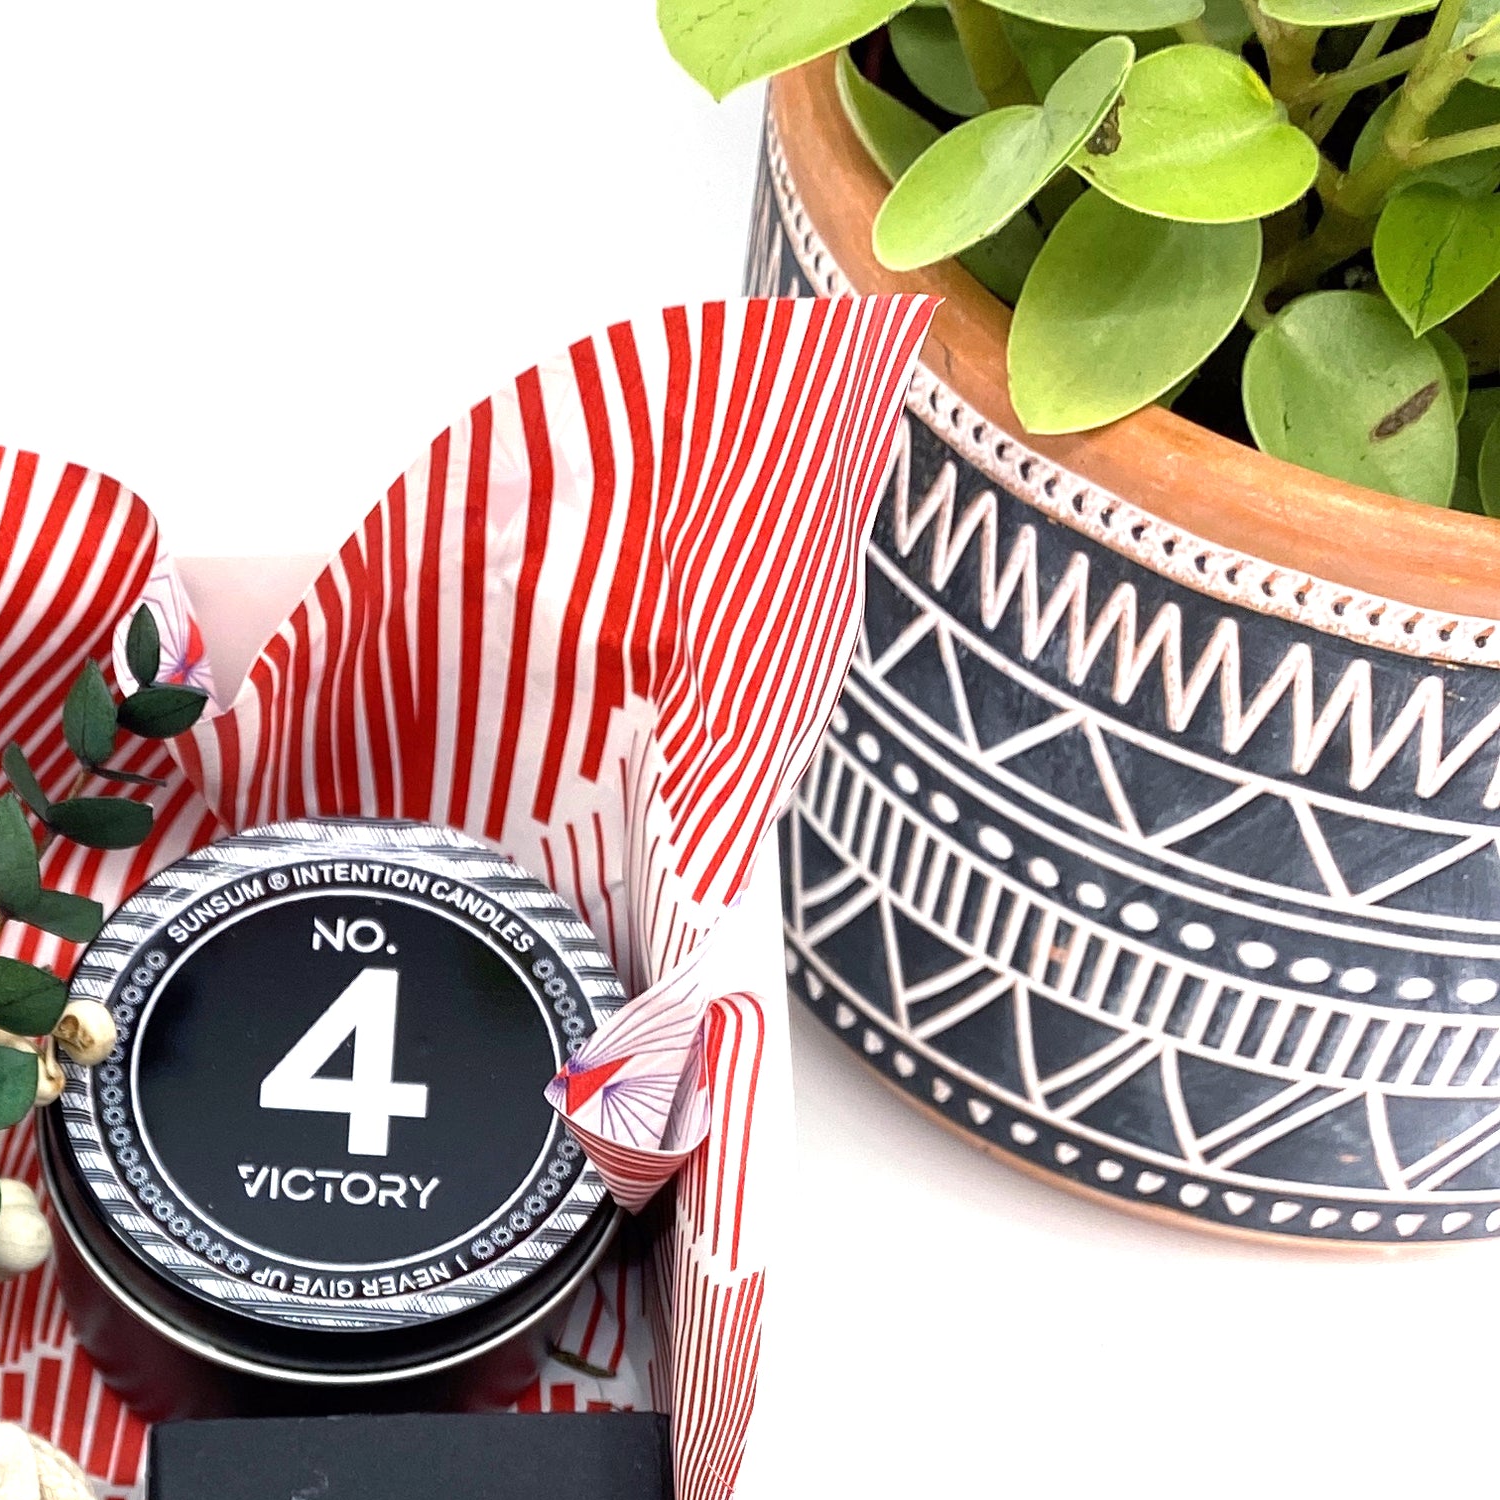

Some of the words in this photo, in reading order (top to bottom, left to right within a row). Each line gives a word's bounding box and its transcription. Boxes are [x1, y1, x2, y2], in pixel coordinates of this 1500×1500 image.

[166, 879, 265, 944] SUNSUM
[291, 862, 429, 894] INTENTION
[430, 879, 535, 954] CANDLES
[311, 914, 398, 955] NO.
[259, 967, 428, 1157] 4
[237, 1164, 440, 1210] VICTORY
[251, 1266, 287, 1290] UP
[292, 1275, 354, 1298] GIVE
[361, 1261, 452, 1297] NEVER
